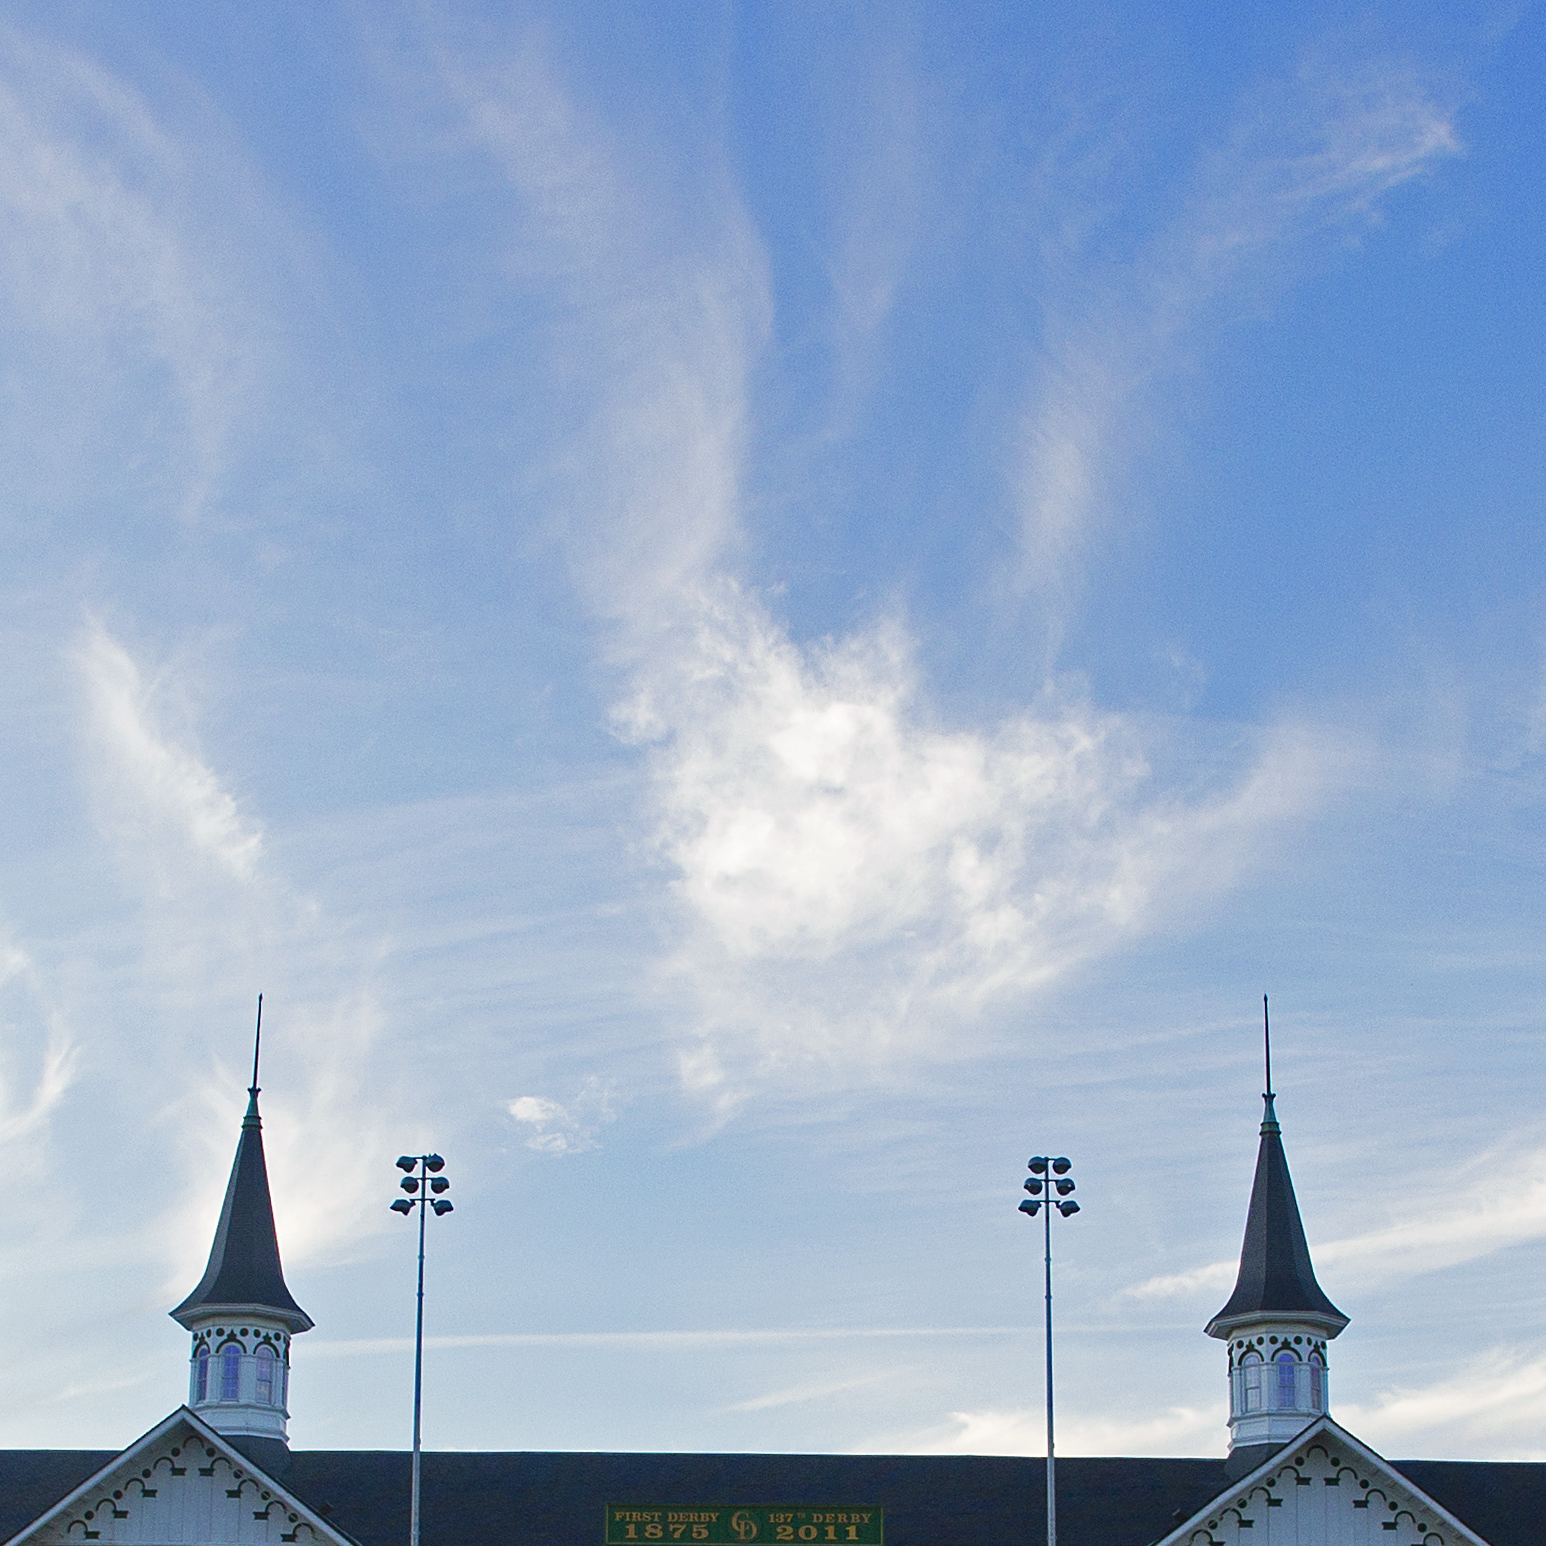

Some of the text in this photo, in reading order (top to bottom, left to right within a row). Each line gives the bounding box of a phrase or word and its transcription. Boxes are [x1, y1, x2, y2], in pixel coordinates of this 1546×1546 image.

[614, 1511, 720, 1523] FIRST DERBY
[812, 1513, 872, 1524] DERBY
[624, 1523, 709, 1540] 1875
[775, 1524, 860, 1541] 2011
